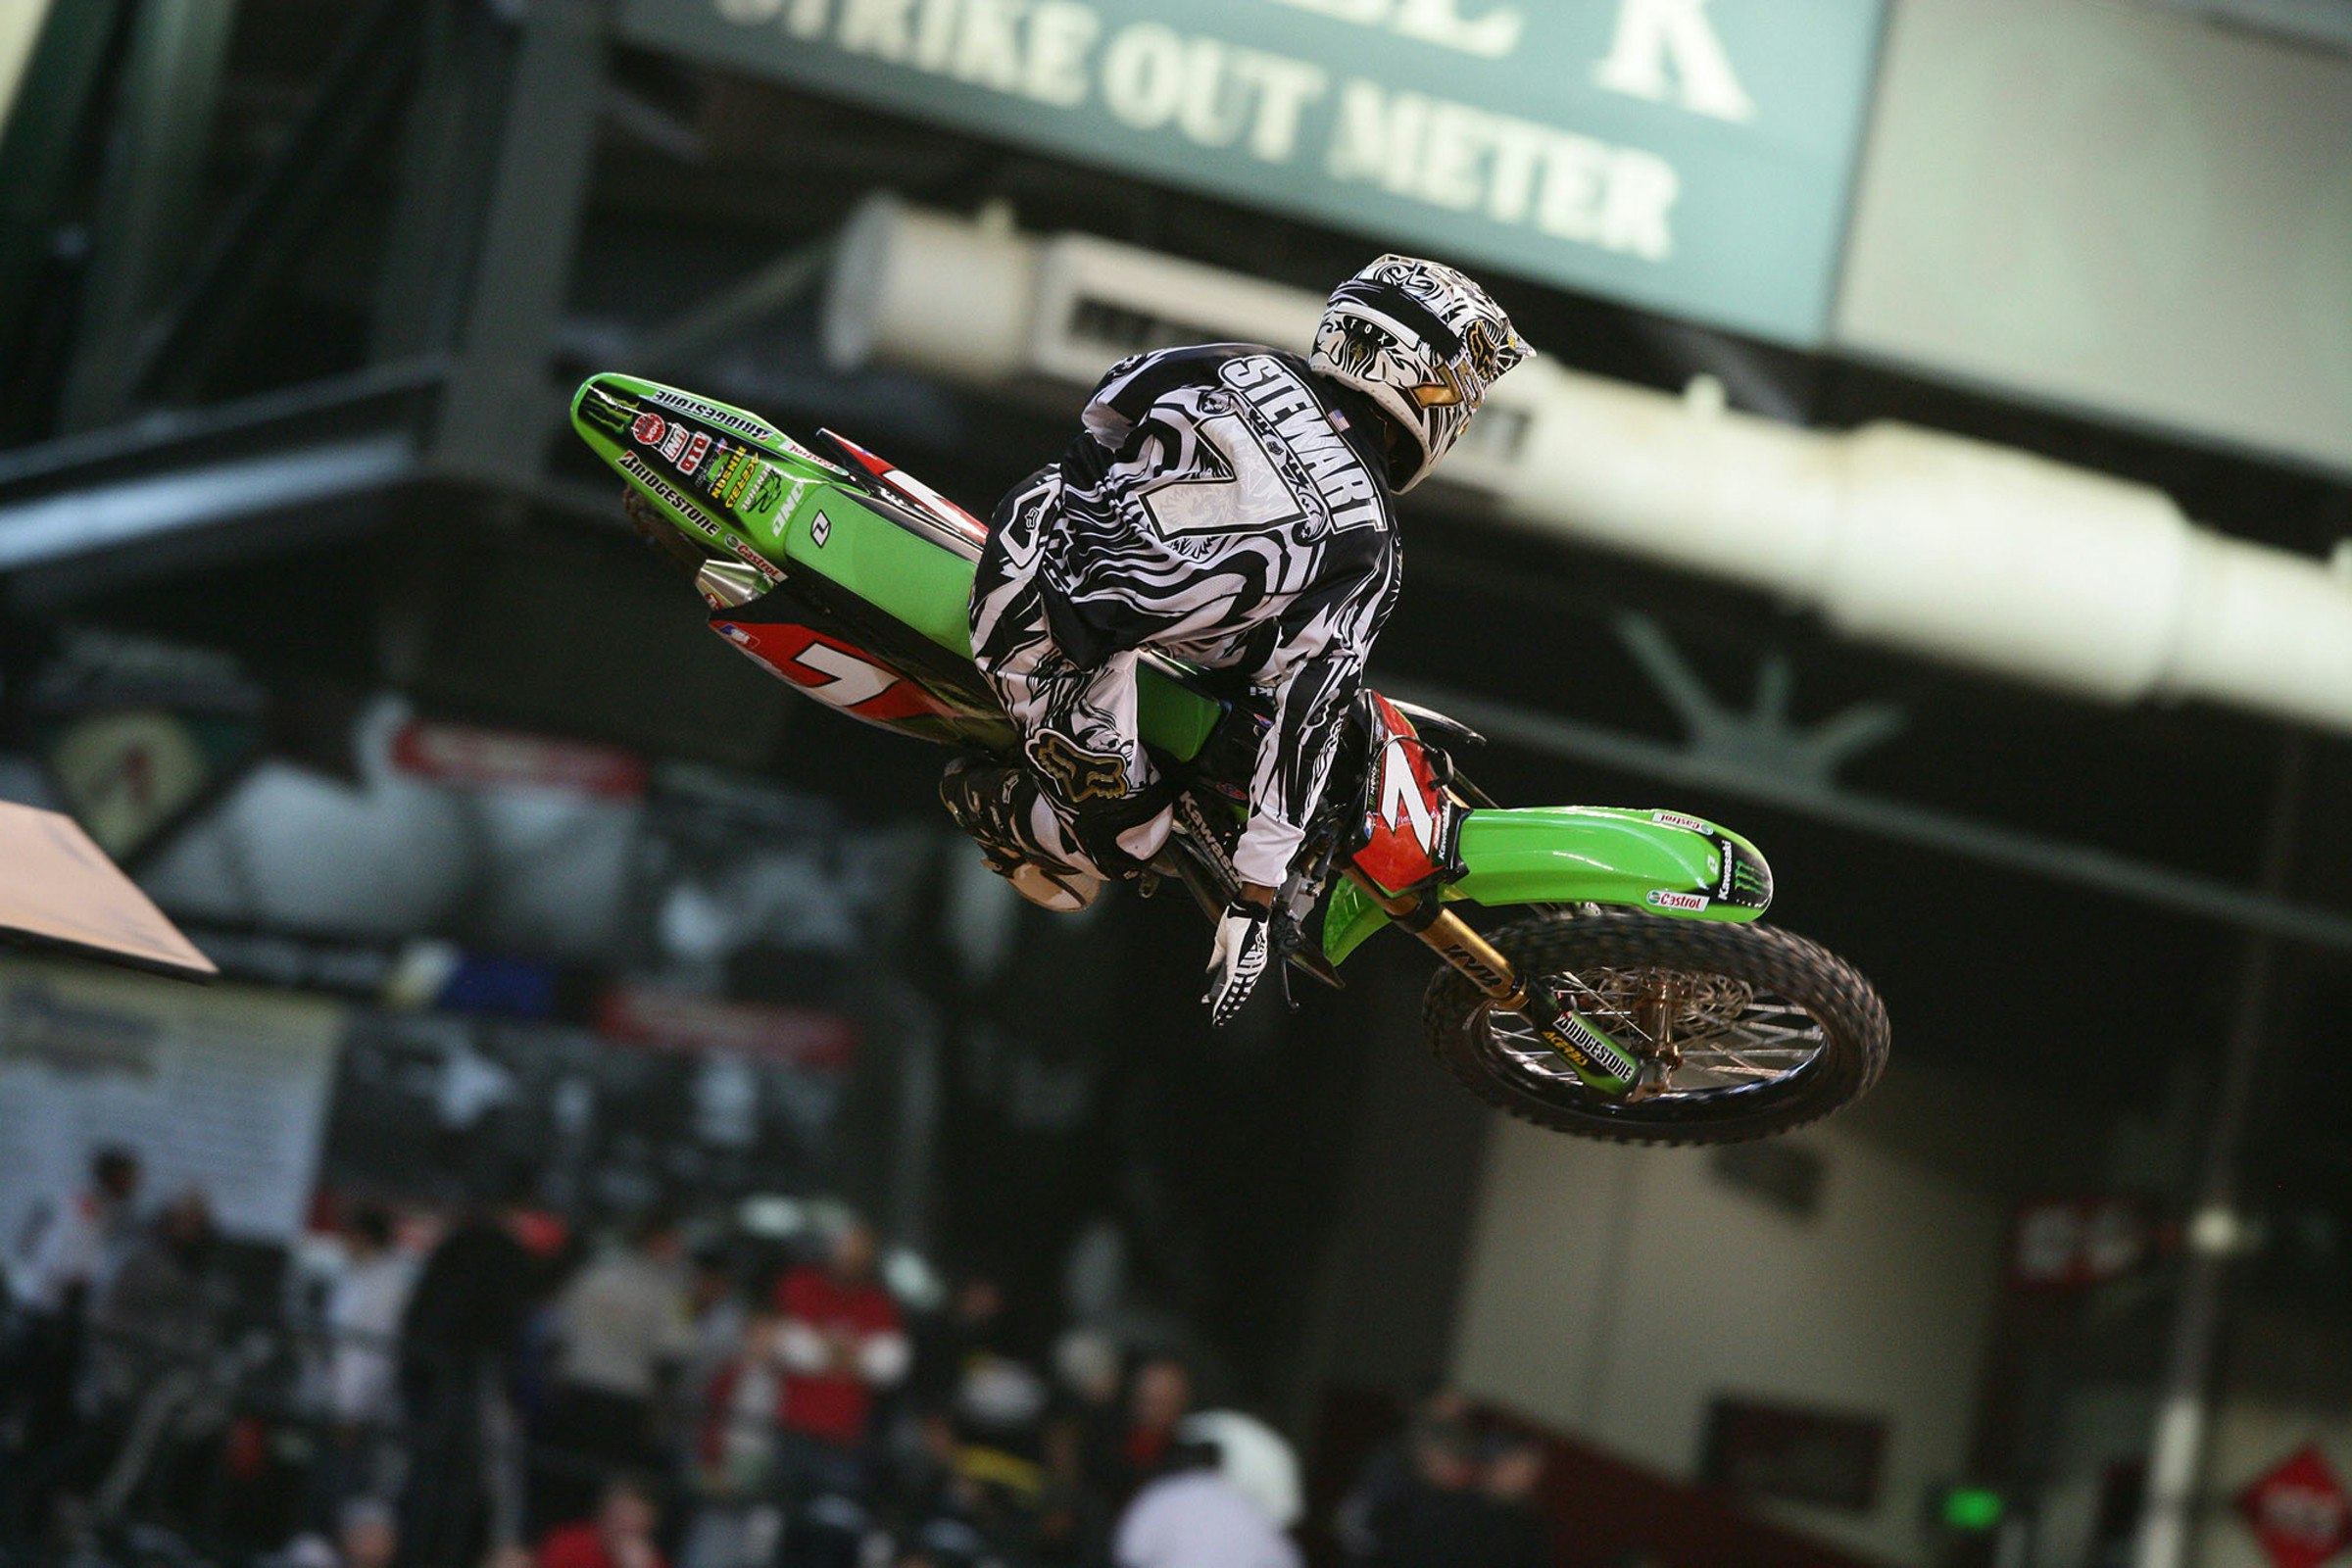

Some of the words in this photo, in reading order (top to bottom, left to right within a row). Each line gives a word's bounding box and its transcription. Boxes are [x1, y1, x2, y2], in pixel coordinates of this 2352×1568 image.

[1102, 22, 1325, 164] OUT
[1325, 76, 1679, 263] METER
[654, 390, 772, 442] BRIDGESTONE
[1220, 355, 1388, 533] STEWART
[617, 451, 720, 536] BRIDGESTONE
[1138, 411, 1308, 540] 7
[736, 544, 779, 578] Castrol
[794, 643, 901, 707] 7
[1381, 728, 1434, 857] 7
[1660, 814, 1700, 830] Castrol
[1660, 893, 1702, 909] Castrol
[1718, 840, 1733, 901] Kawasaki
[1542, 1030, 1589, 1066] ACERBIS
[1554, 1015, 1634, 1083] BRIDGESTONE
